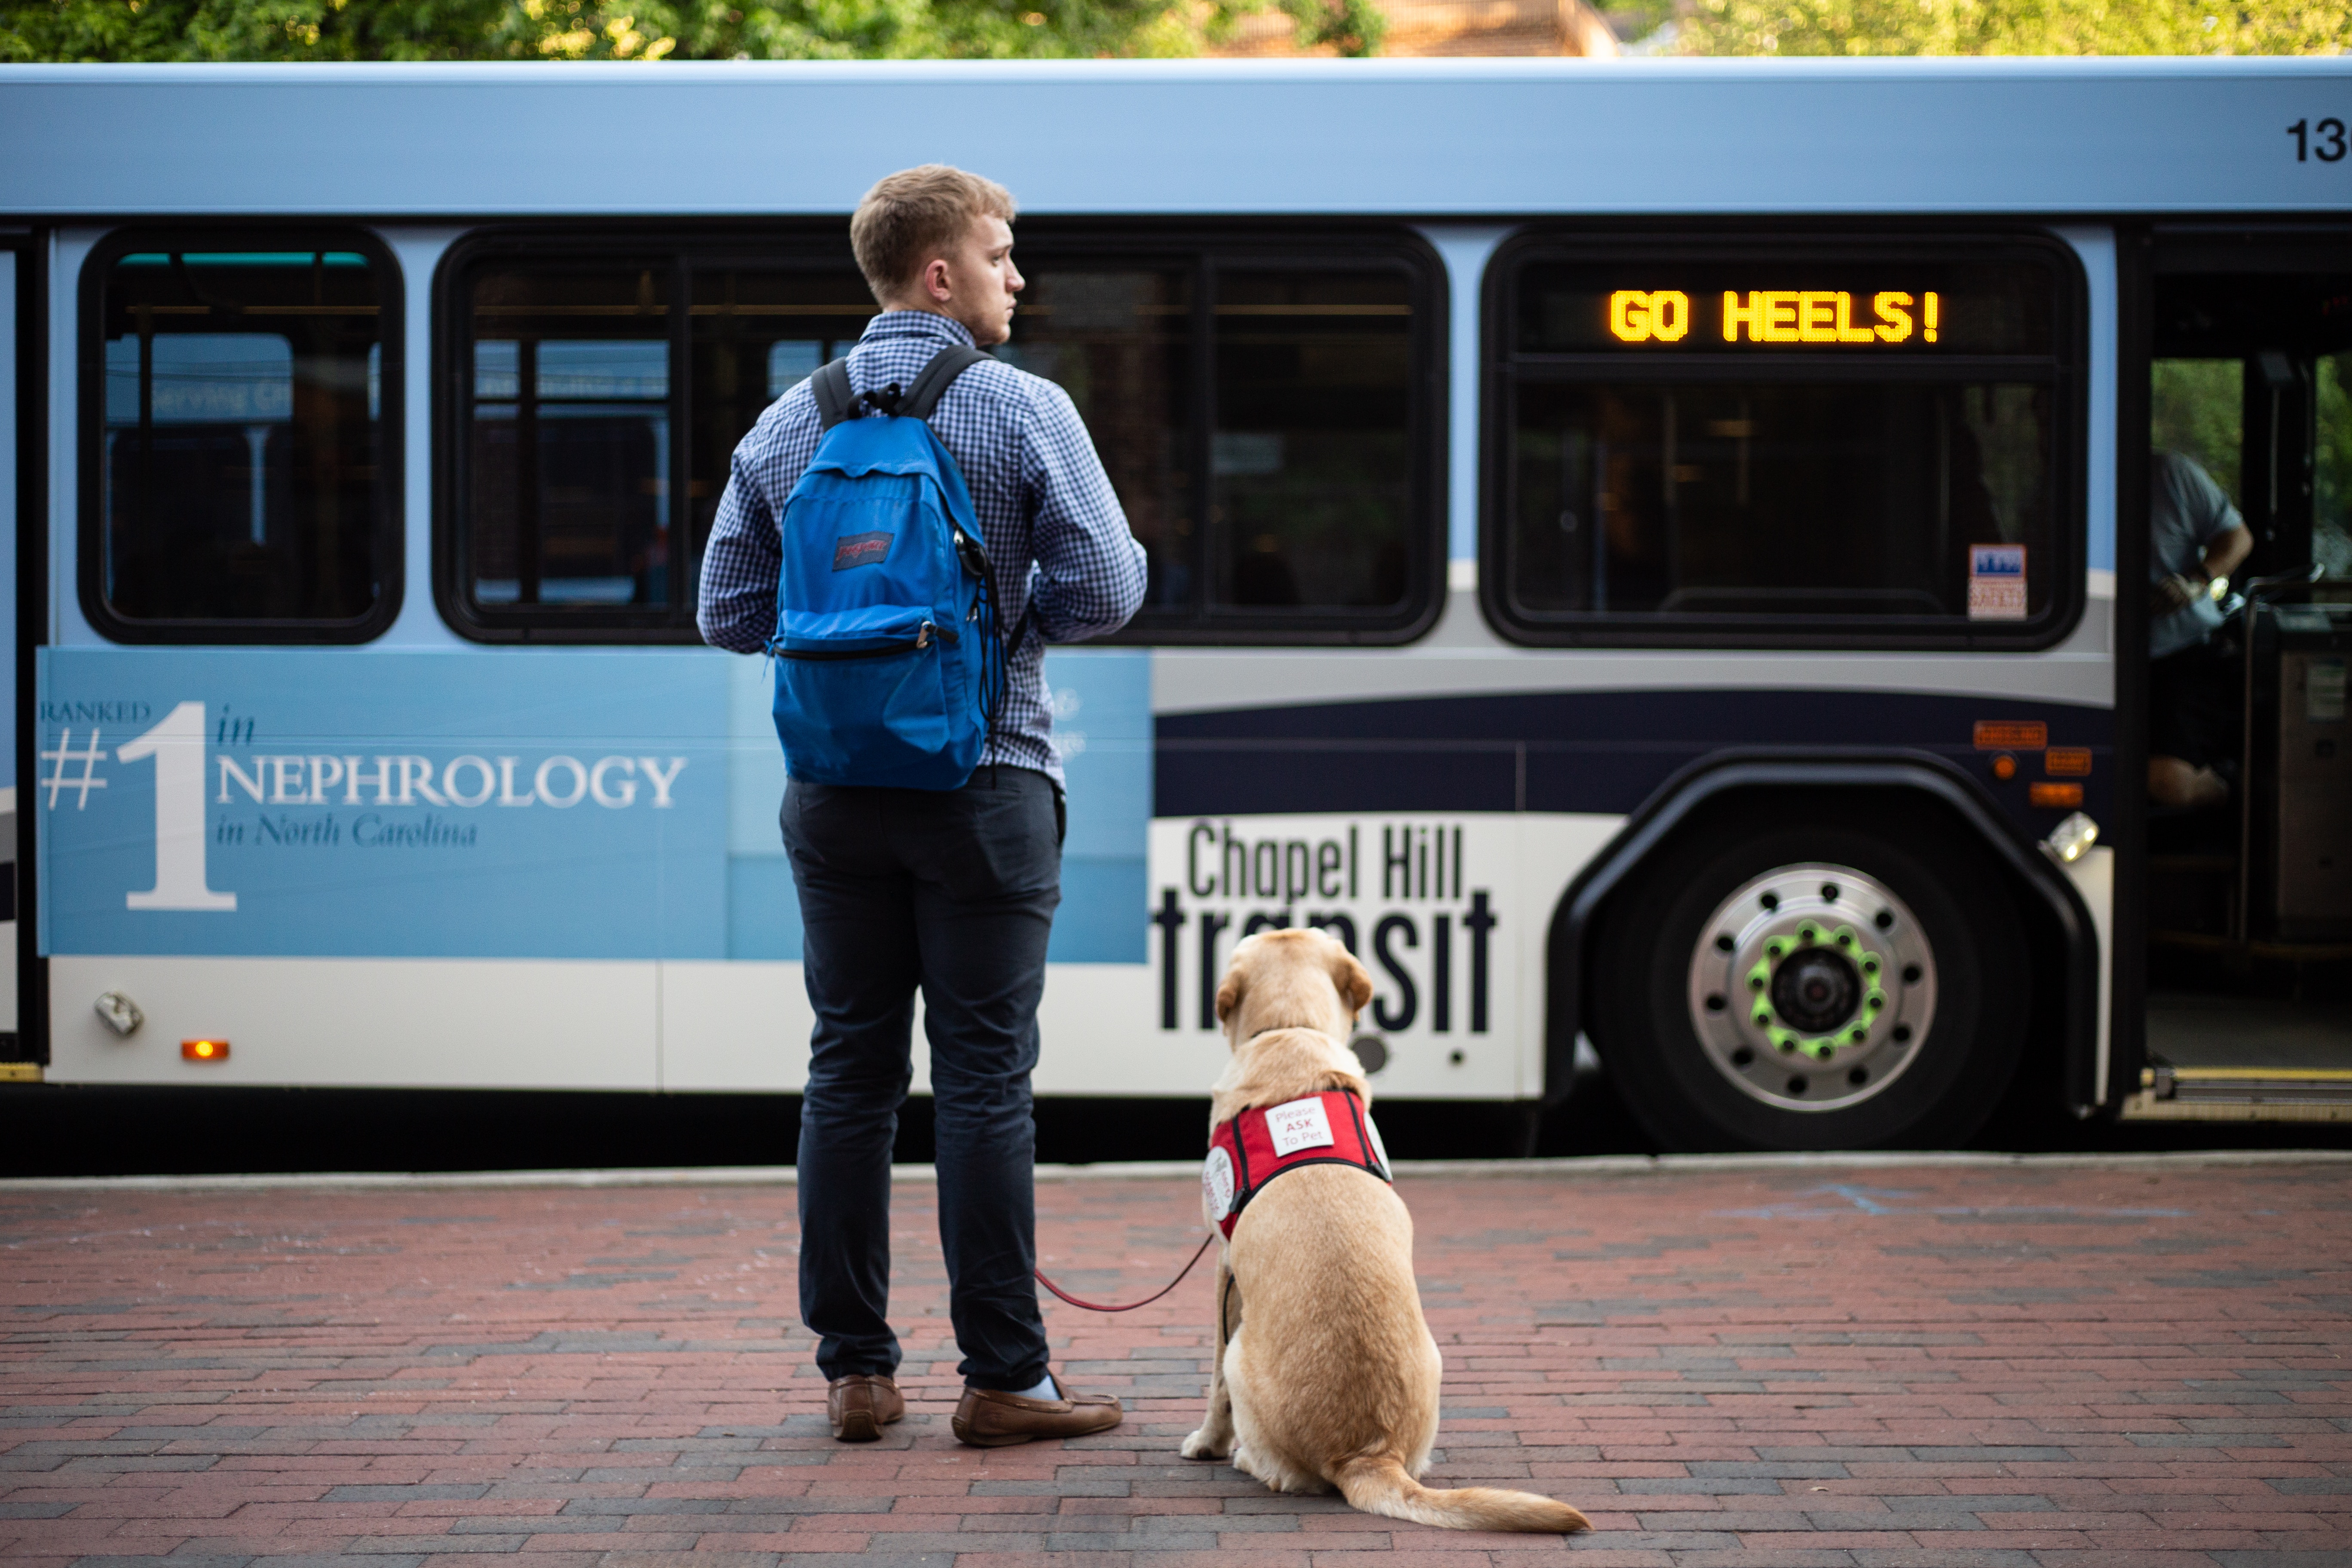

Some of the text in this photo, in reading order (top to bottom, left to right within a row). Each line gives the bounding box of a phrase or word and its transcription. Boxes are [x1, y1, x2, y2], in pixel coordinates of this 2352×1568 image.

[2286, 117, 2352, 163] 13
[1611, 290, 1938, 342] GO HEELS!
[40, 701, 151, 723] RANKED
[217, 703, 255, 747] in
[215, 754, 687, 809] NEPHROLOGY
[40, 701, 237, 911] #1
[217, 812, 477, 848] in North Carolina
[1187, 820, 1463, 908] Chapel Hill
[1151, 888, 1497, 1033] trsit
[1275, 1107, 1315, 1122] Please
[1286, 1118, 1313, 1133] ASK
[1282, 1131, 1323, 1146] To Pet
